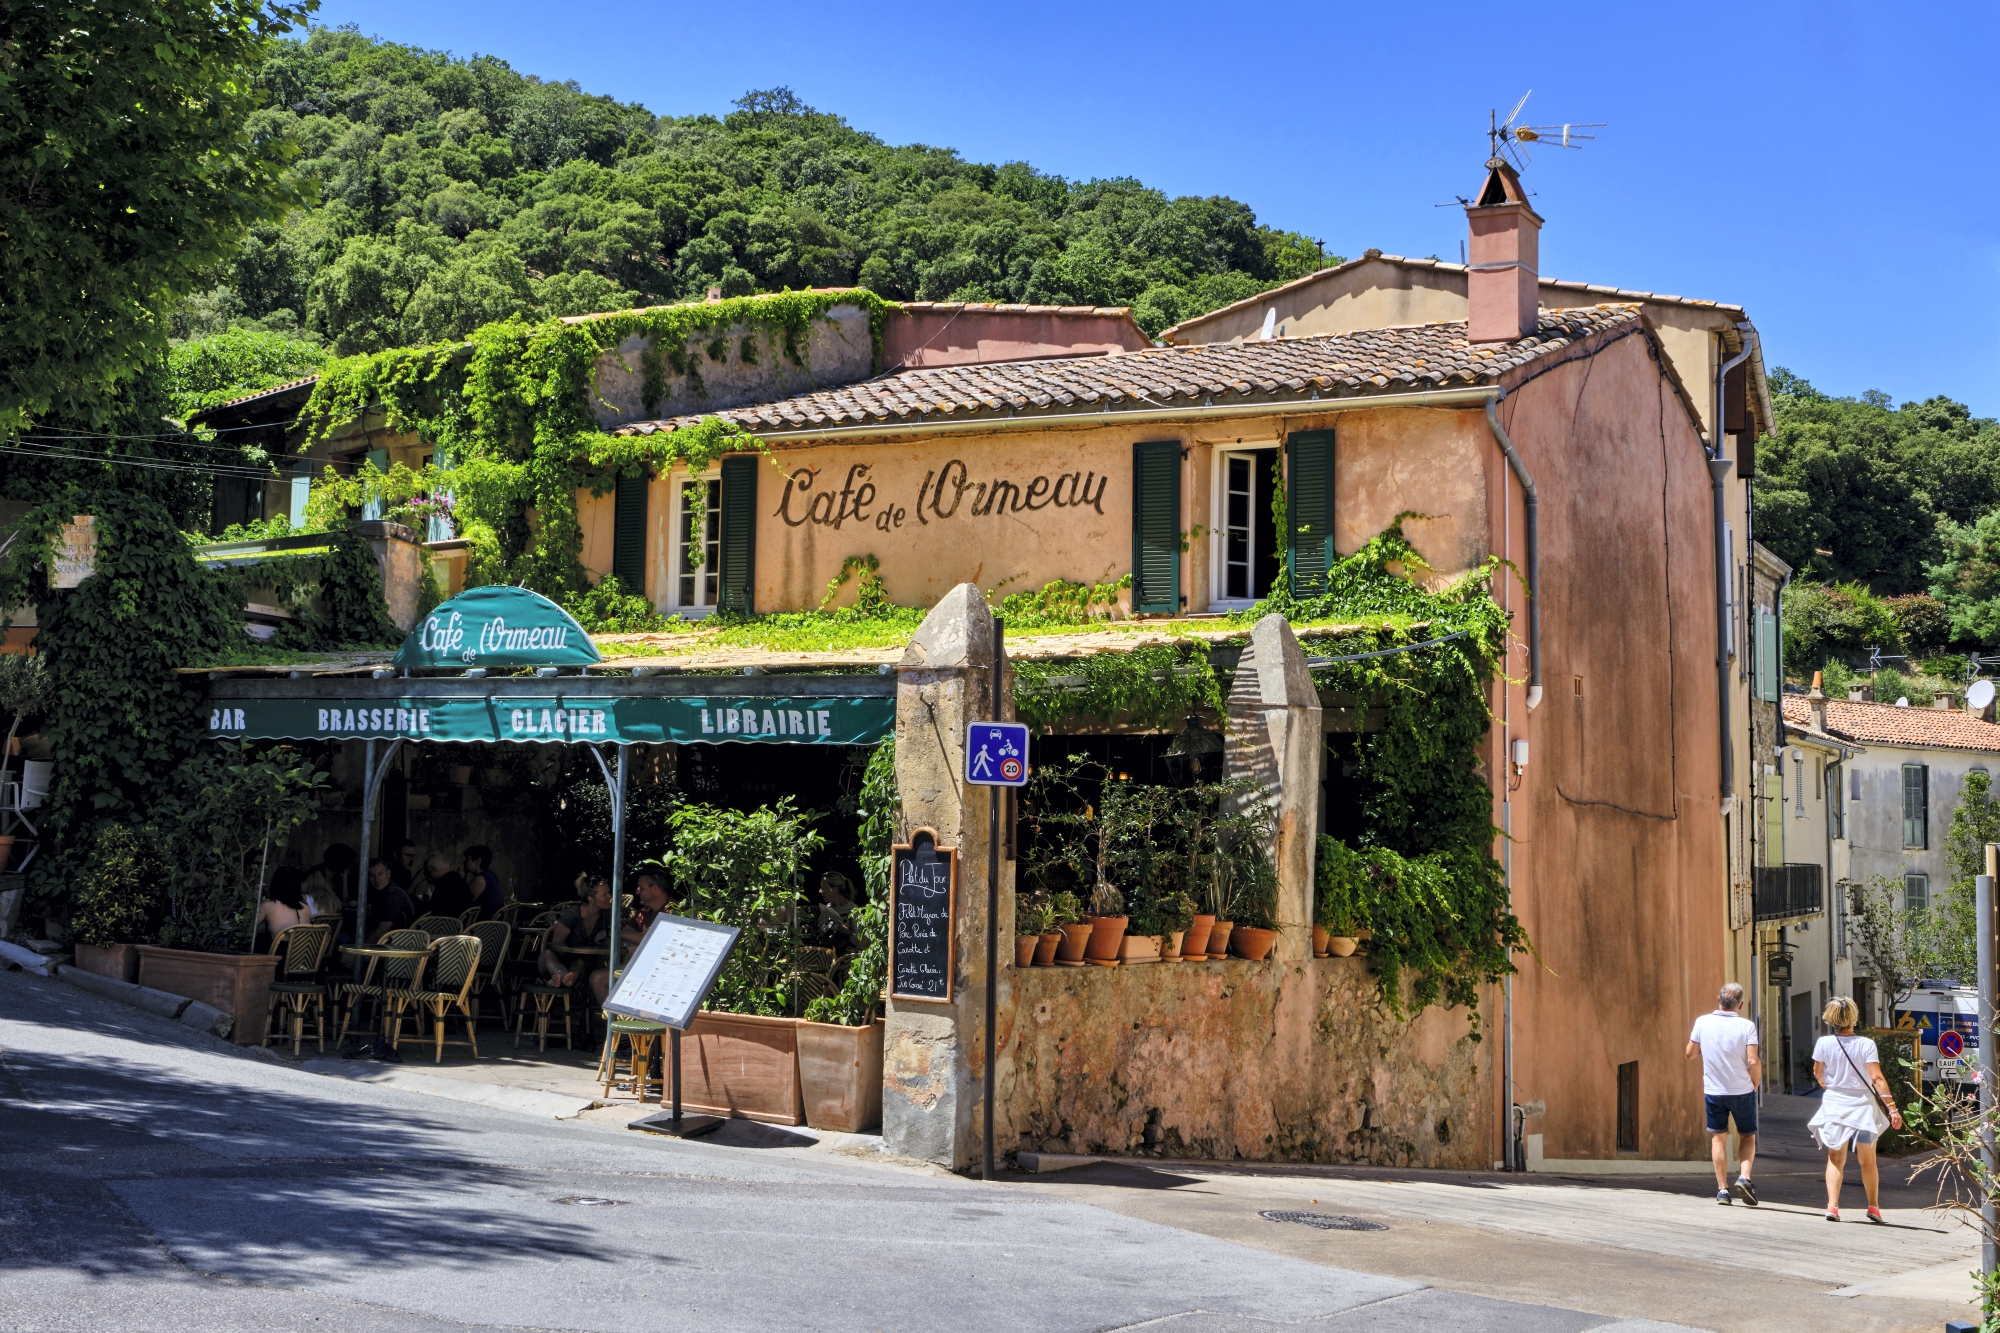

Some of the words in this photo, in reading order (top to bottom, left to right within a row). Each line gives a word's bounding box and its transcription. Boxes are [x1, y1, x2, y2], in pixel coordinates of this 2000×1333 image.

[773, 463, 876, 530] Café
[876, 503, 906, 532] de
[917, 459, 1107, 526] l'Ormeau
[419, 612, 464, 656] Café
[462, 647, 476, 663] de
[480, 616, 568, 655] l'Ormeau
[210, 708, 246, 730] BAR
[318, 708, 430, 731] BRASSERIE
[511, 708, 606, 734] GLACIER
[701, 708, 832, 735] LIBRAIRIE
[1005, 765, 1018, 774] 20
[919, 868, 929, 883] du
